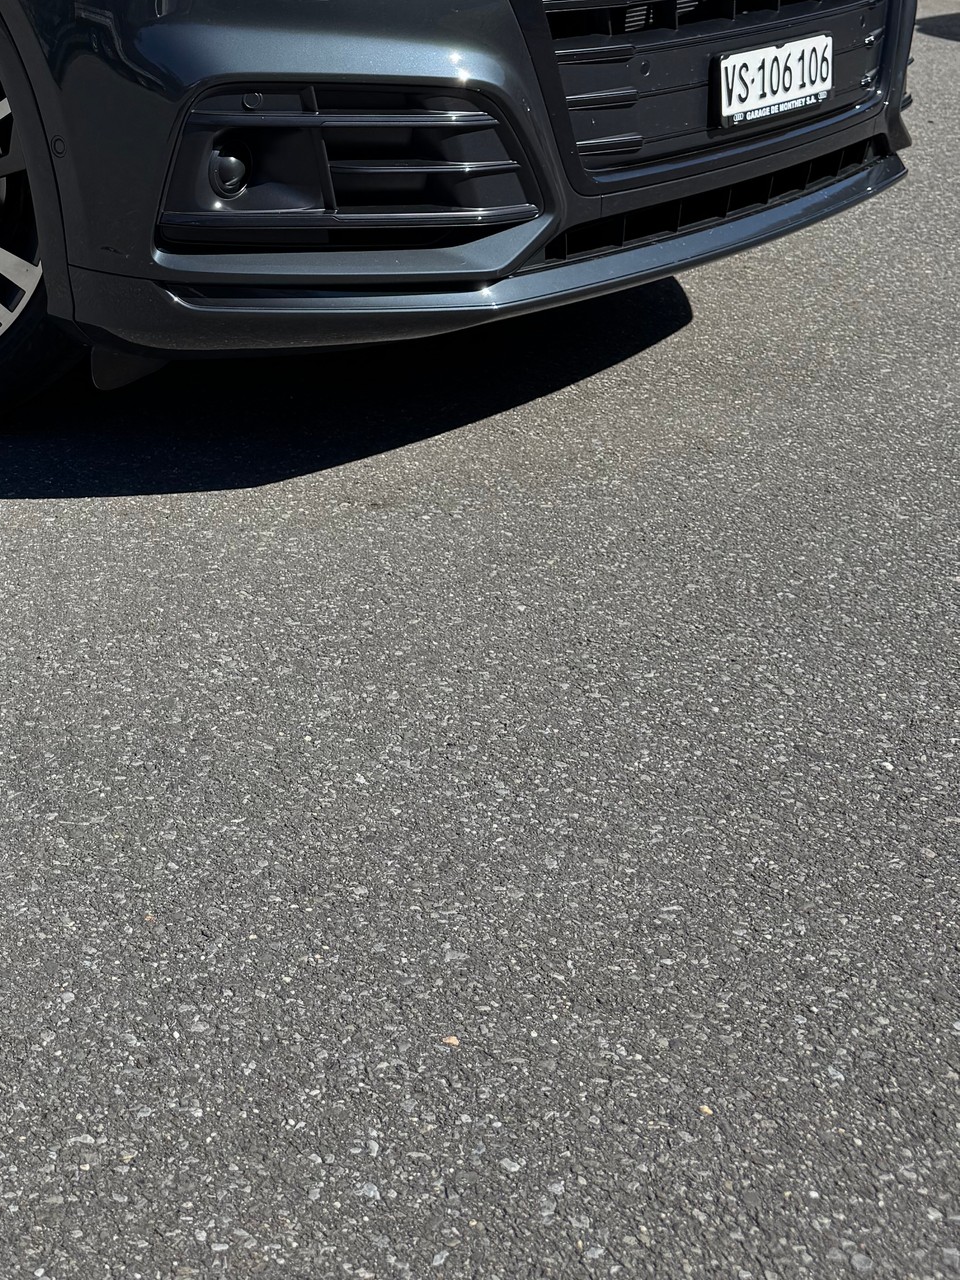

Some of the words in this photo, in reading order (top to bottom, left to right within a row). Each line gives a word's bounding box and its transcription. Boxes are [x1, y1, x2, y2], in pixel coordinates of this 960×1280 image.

[746, 106, 771, 120] GARAGE
[770, 104, 779, 115] DE
[779, 97, 806, 112] MONTHEY
